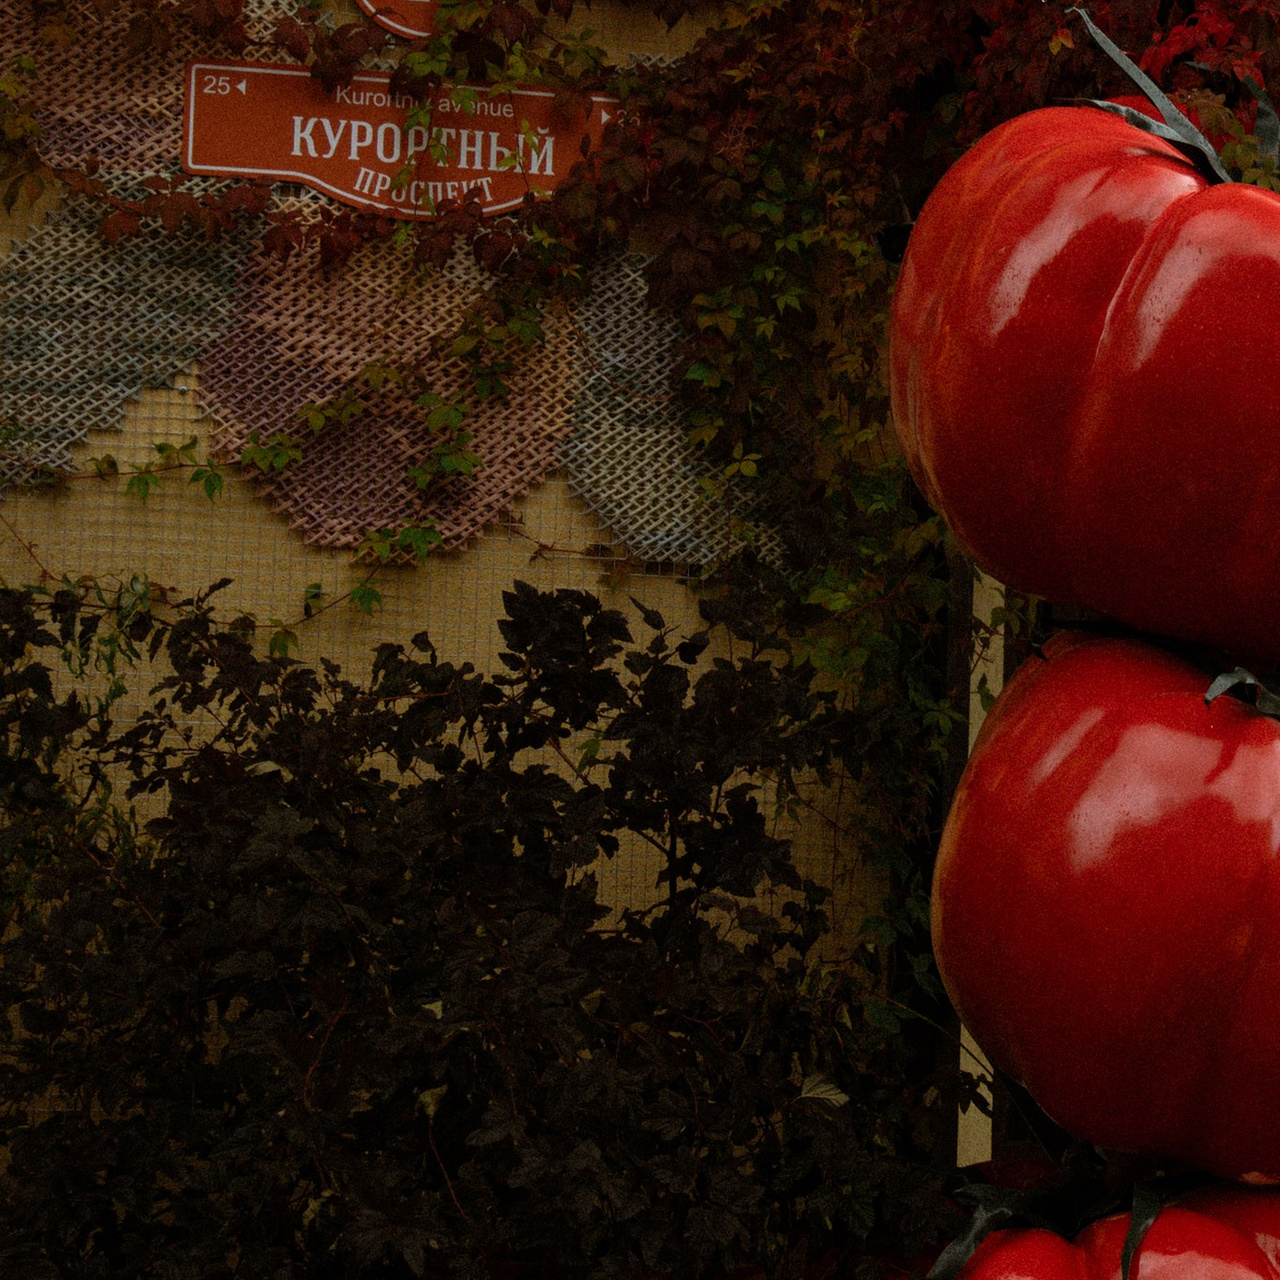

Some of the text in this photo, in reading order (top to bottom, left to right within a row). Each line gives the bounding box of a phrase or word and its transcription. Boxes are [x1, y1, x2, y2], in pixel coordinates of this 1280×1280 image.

[202, 75, 231, 95] 25
[438, 97, 515, 118] avnue
[290, 115, 556, 177] КУРОРТНЫЙ
